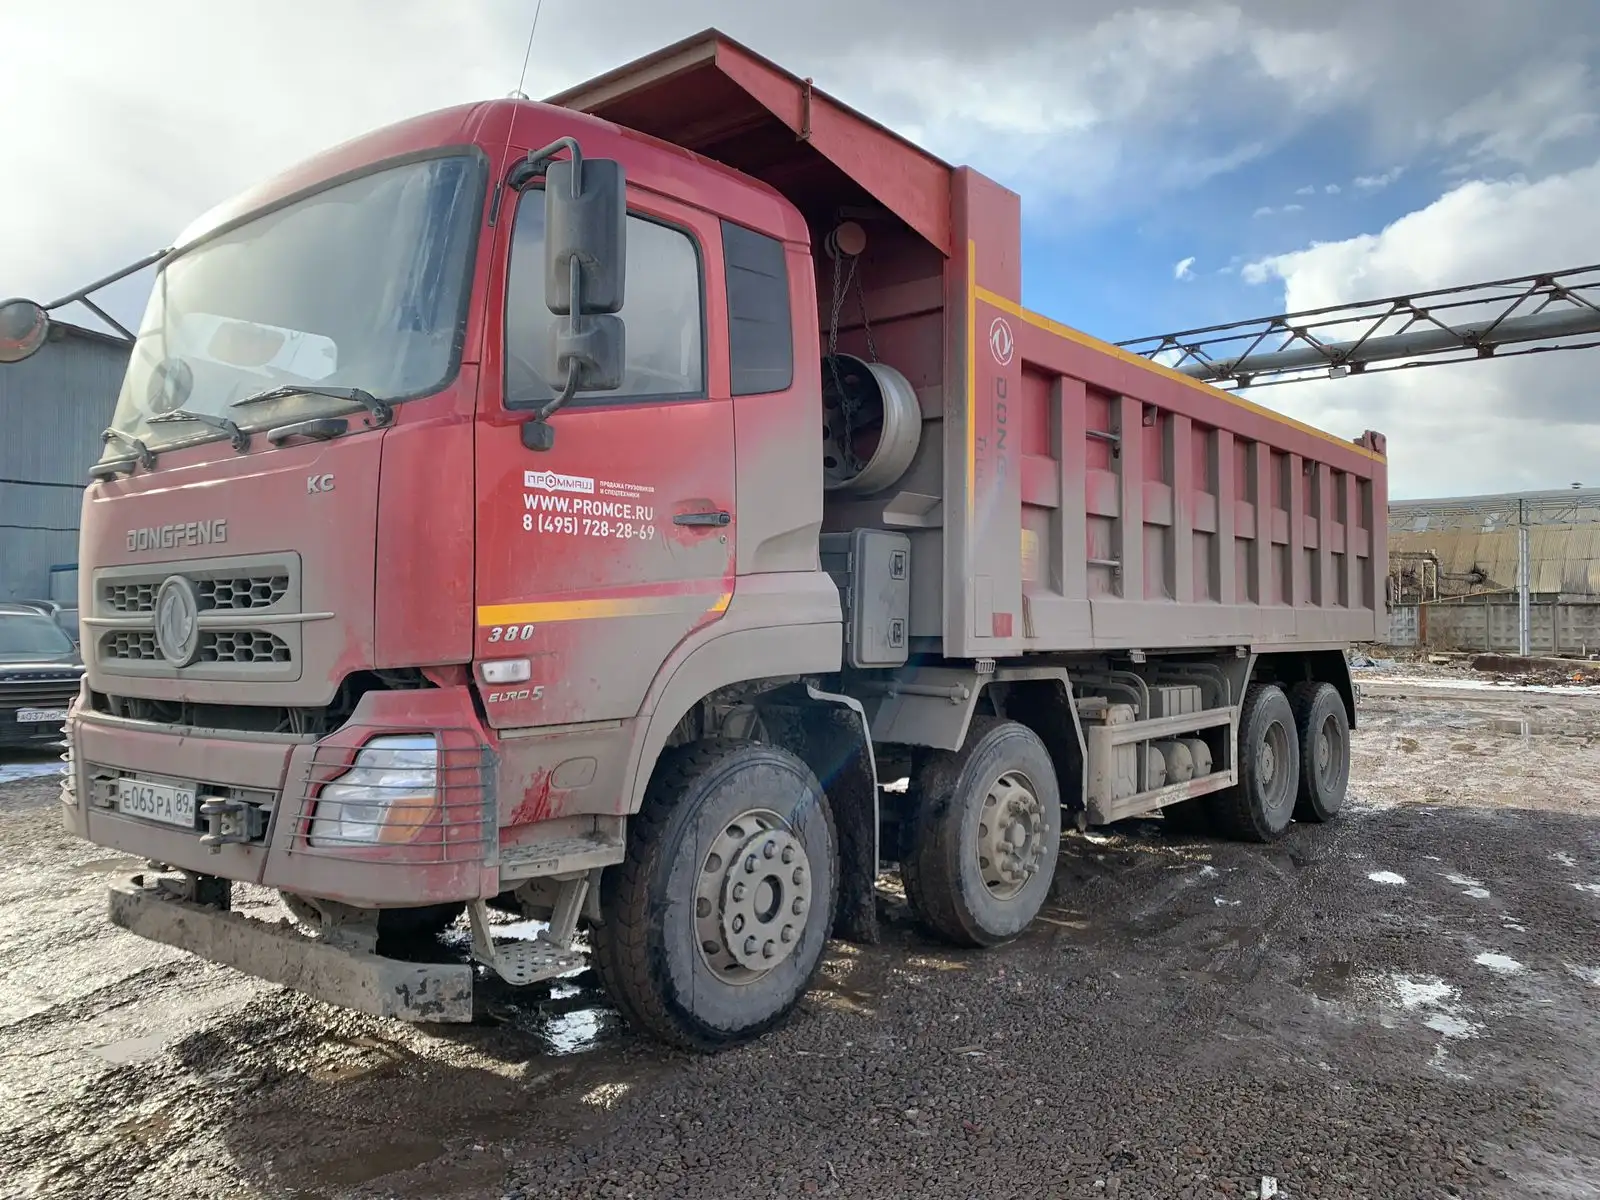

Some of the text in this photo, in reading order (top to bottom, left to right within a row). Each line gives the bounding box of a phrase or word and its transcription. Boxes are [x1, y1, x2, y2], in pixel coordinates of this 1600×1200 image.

[307, 473, 335, 494] KC
[527, 474, 593, 492] ПРОММАШ
[599, 480, 655, 493] ПРОДАЖА ГРУЗОВИКОВ
[604, 489, 640, 499] СПЕЦТЕХНИКИ
[523, 493, 654, 521] WWW.PROMCE.RU
[126, 519, 228, 553] DONGFENG
[523, 513, 655, 541] 8 (495) 728-28-69
[487, 624, 535, 643] 380
[531, 686, 545, 701] 5
[176, 792, 189, 813] 89
